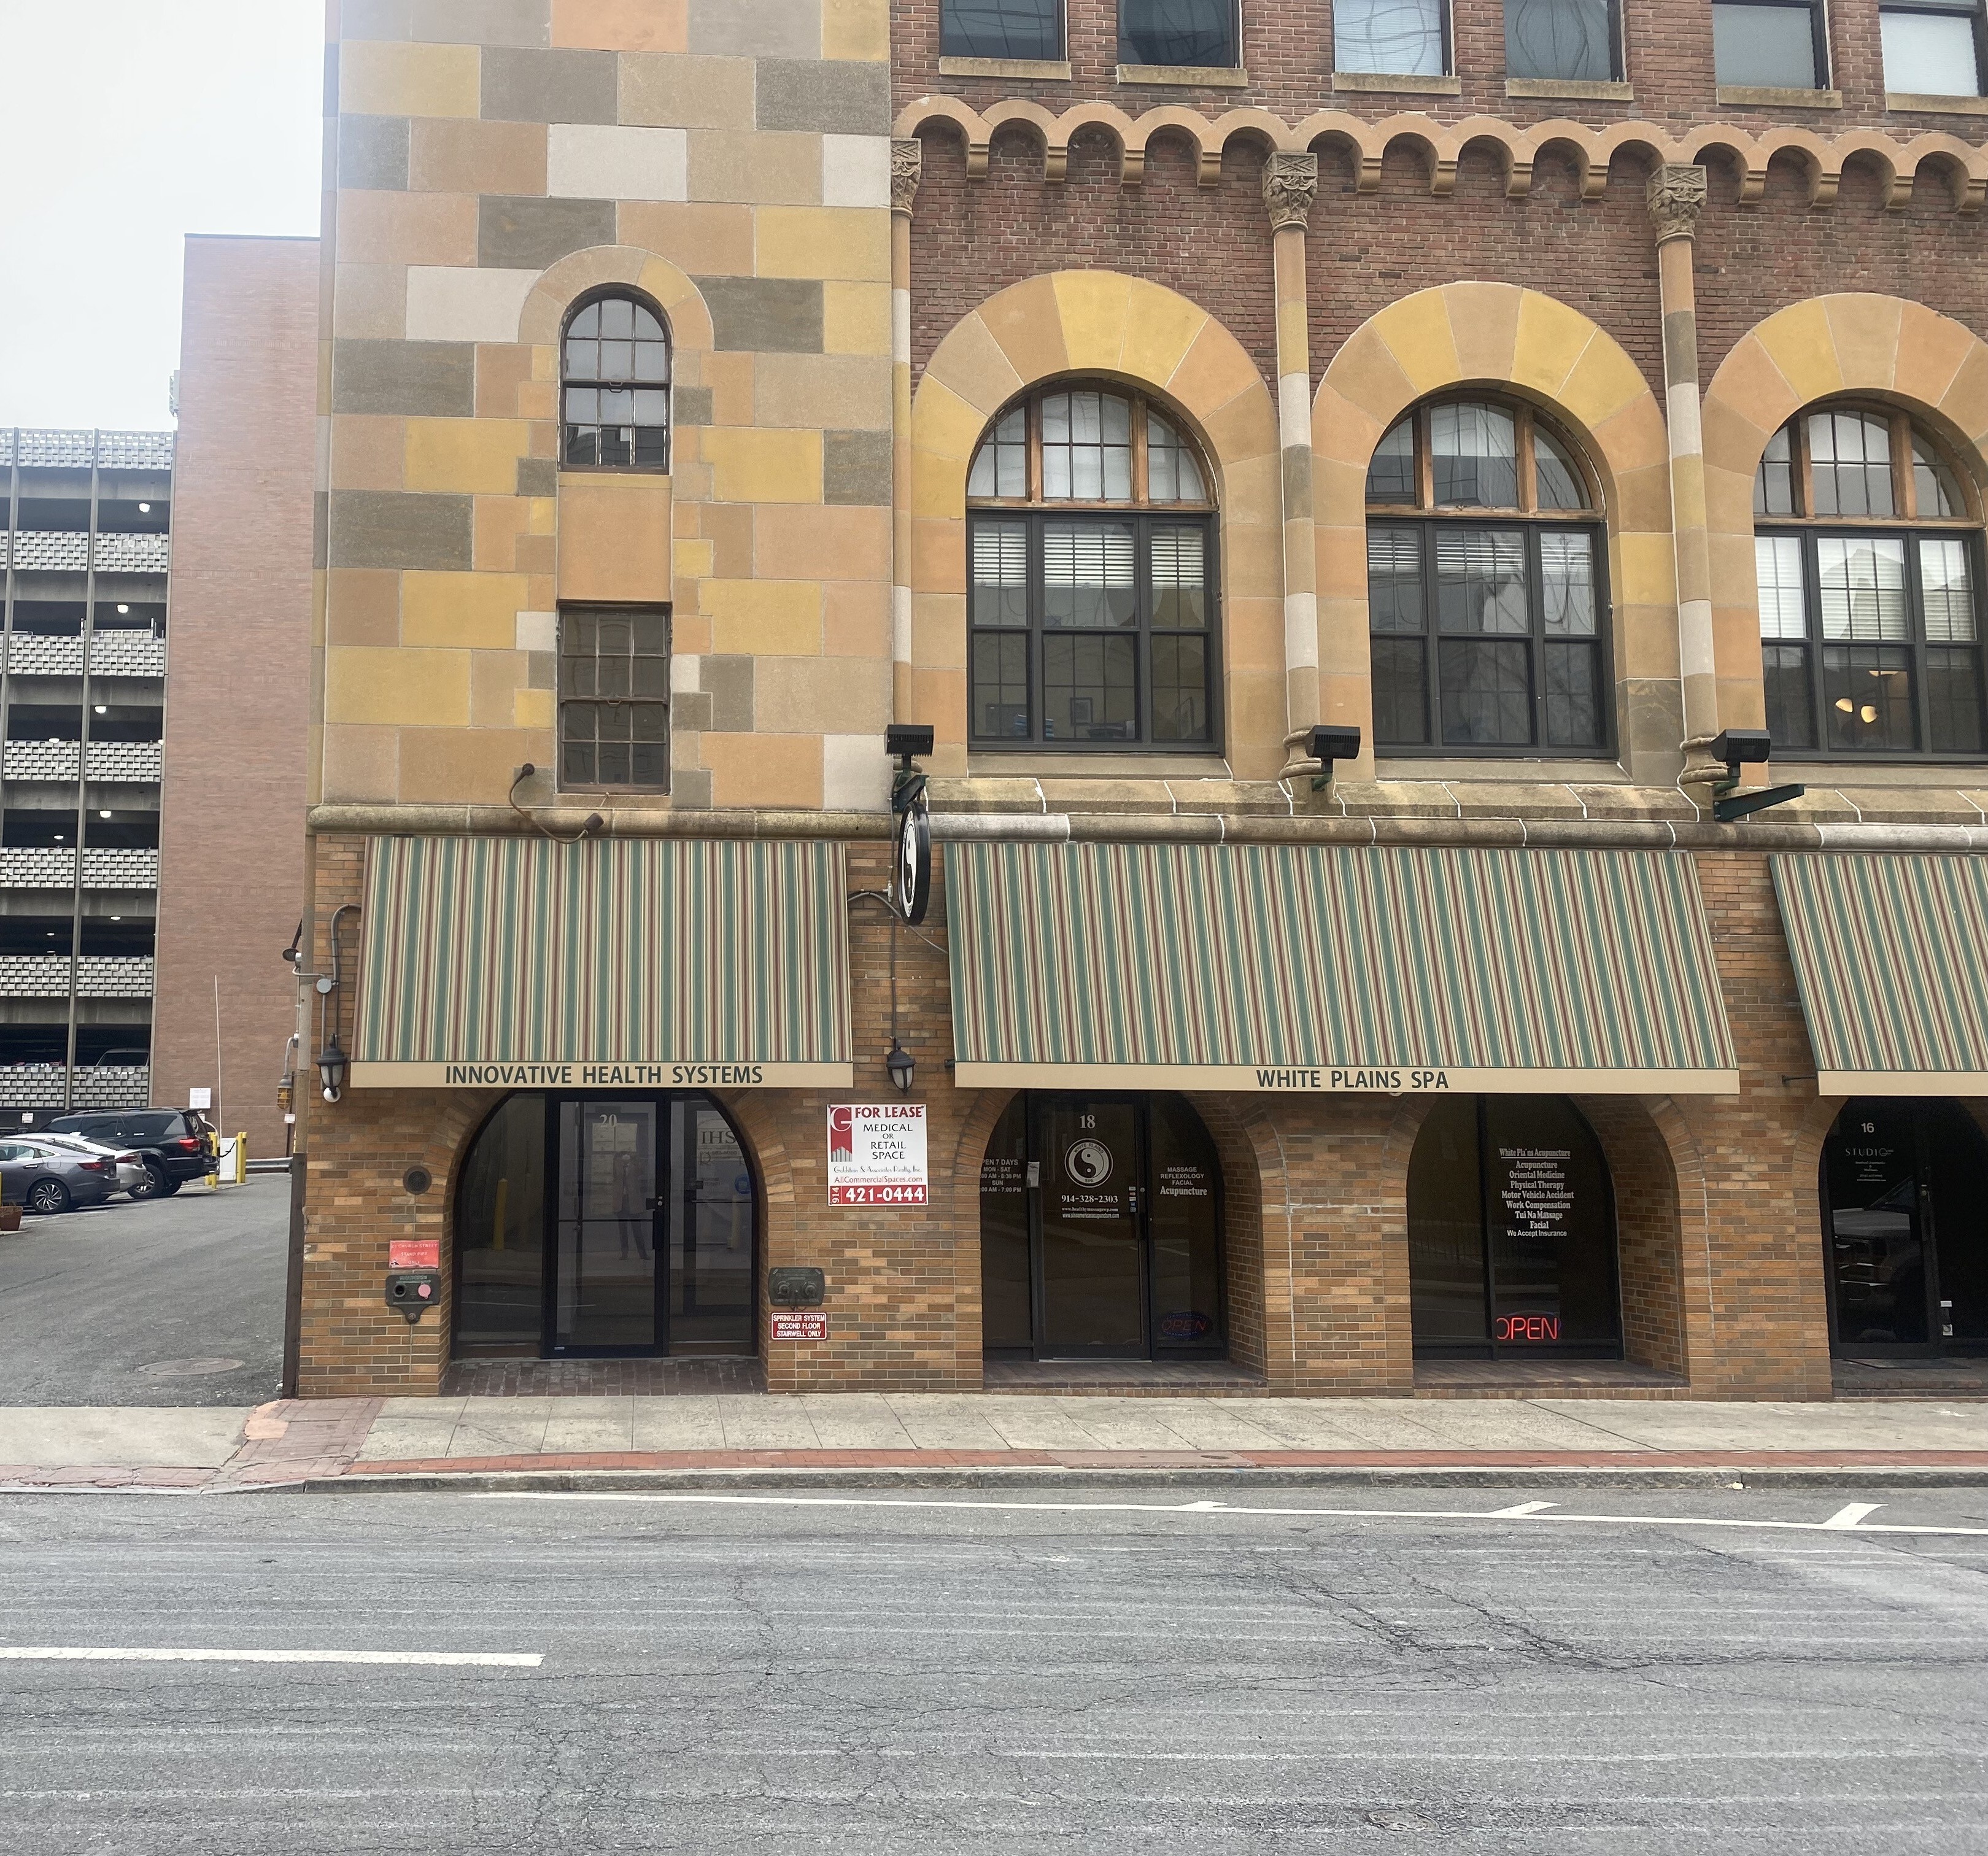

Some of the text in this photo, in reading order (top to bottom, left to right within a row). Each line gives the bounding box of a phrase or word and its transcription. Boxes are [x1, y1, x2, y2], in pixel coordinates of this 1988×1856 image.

[446, 1065, 762, 1084] INNOVATIVE HEALTH SYSTEMS
[1256, 1070, 1448, 1089] WHITE PLAINS SPA
[856, 1107, 922, 1118] FOR LEASE
[599, 1114, 617, 1128] 20
[1080, 1115, 1096, 1129] 18
[1861, 1123, 1874, 1133] 16
[702, 1131, 737, 1143] IHS
[1074, 1143, 1104, 1154] WHITE PLAINS
[1516, 1161, 1557, 1170] Acupuncture
[1510, 1181, 1564, 1190] Physical Therapy
[846, 1187, 924, 1202] 421-0444
[1160, 1186, 1207, 1197] Acupuncture
[1062, 1194, 1118, 1203] 914-328-2303
[1525, 1201, 1571, 1210] Compensation
[1537, 1211, 1563, 1220] Massage
[1496, 1317, 1557, 1339] OPEN
